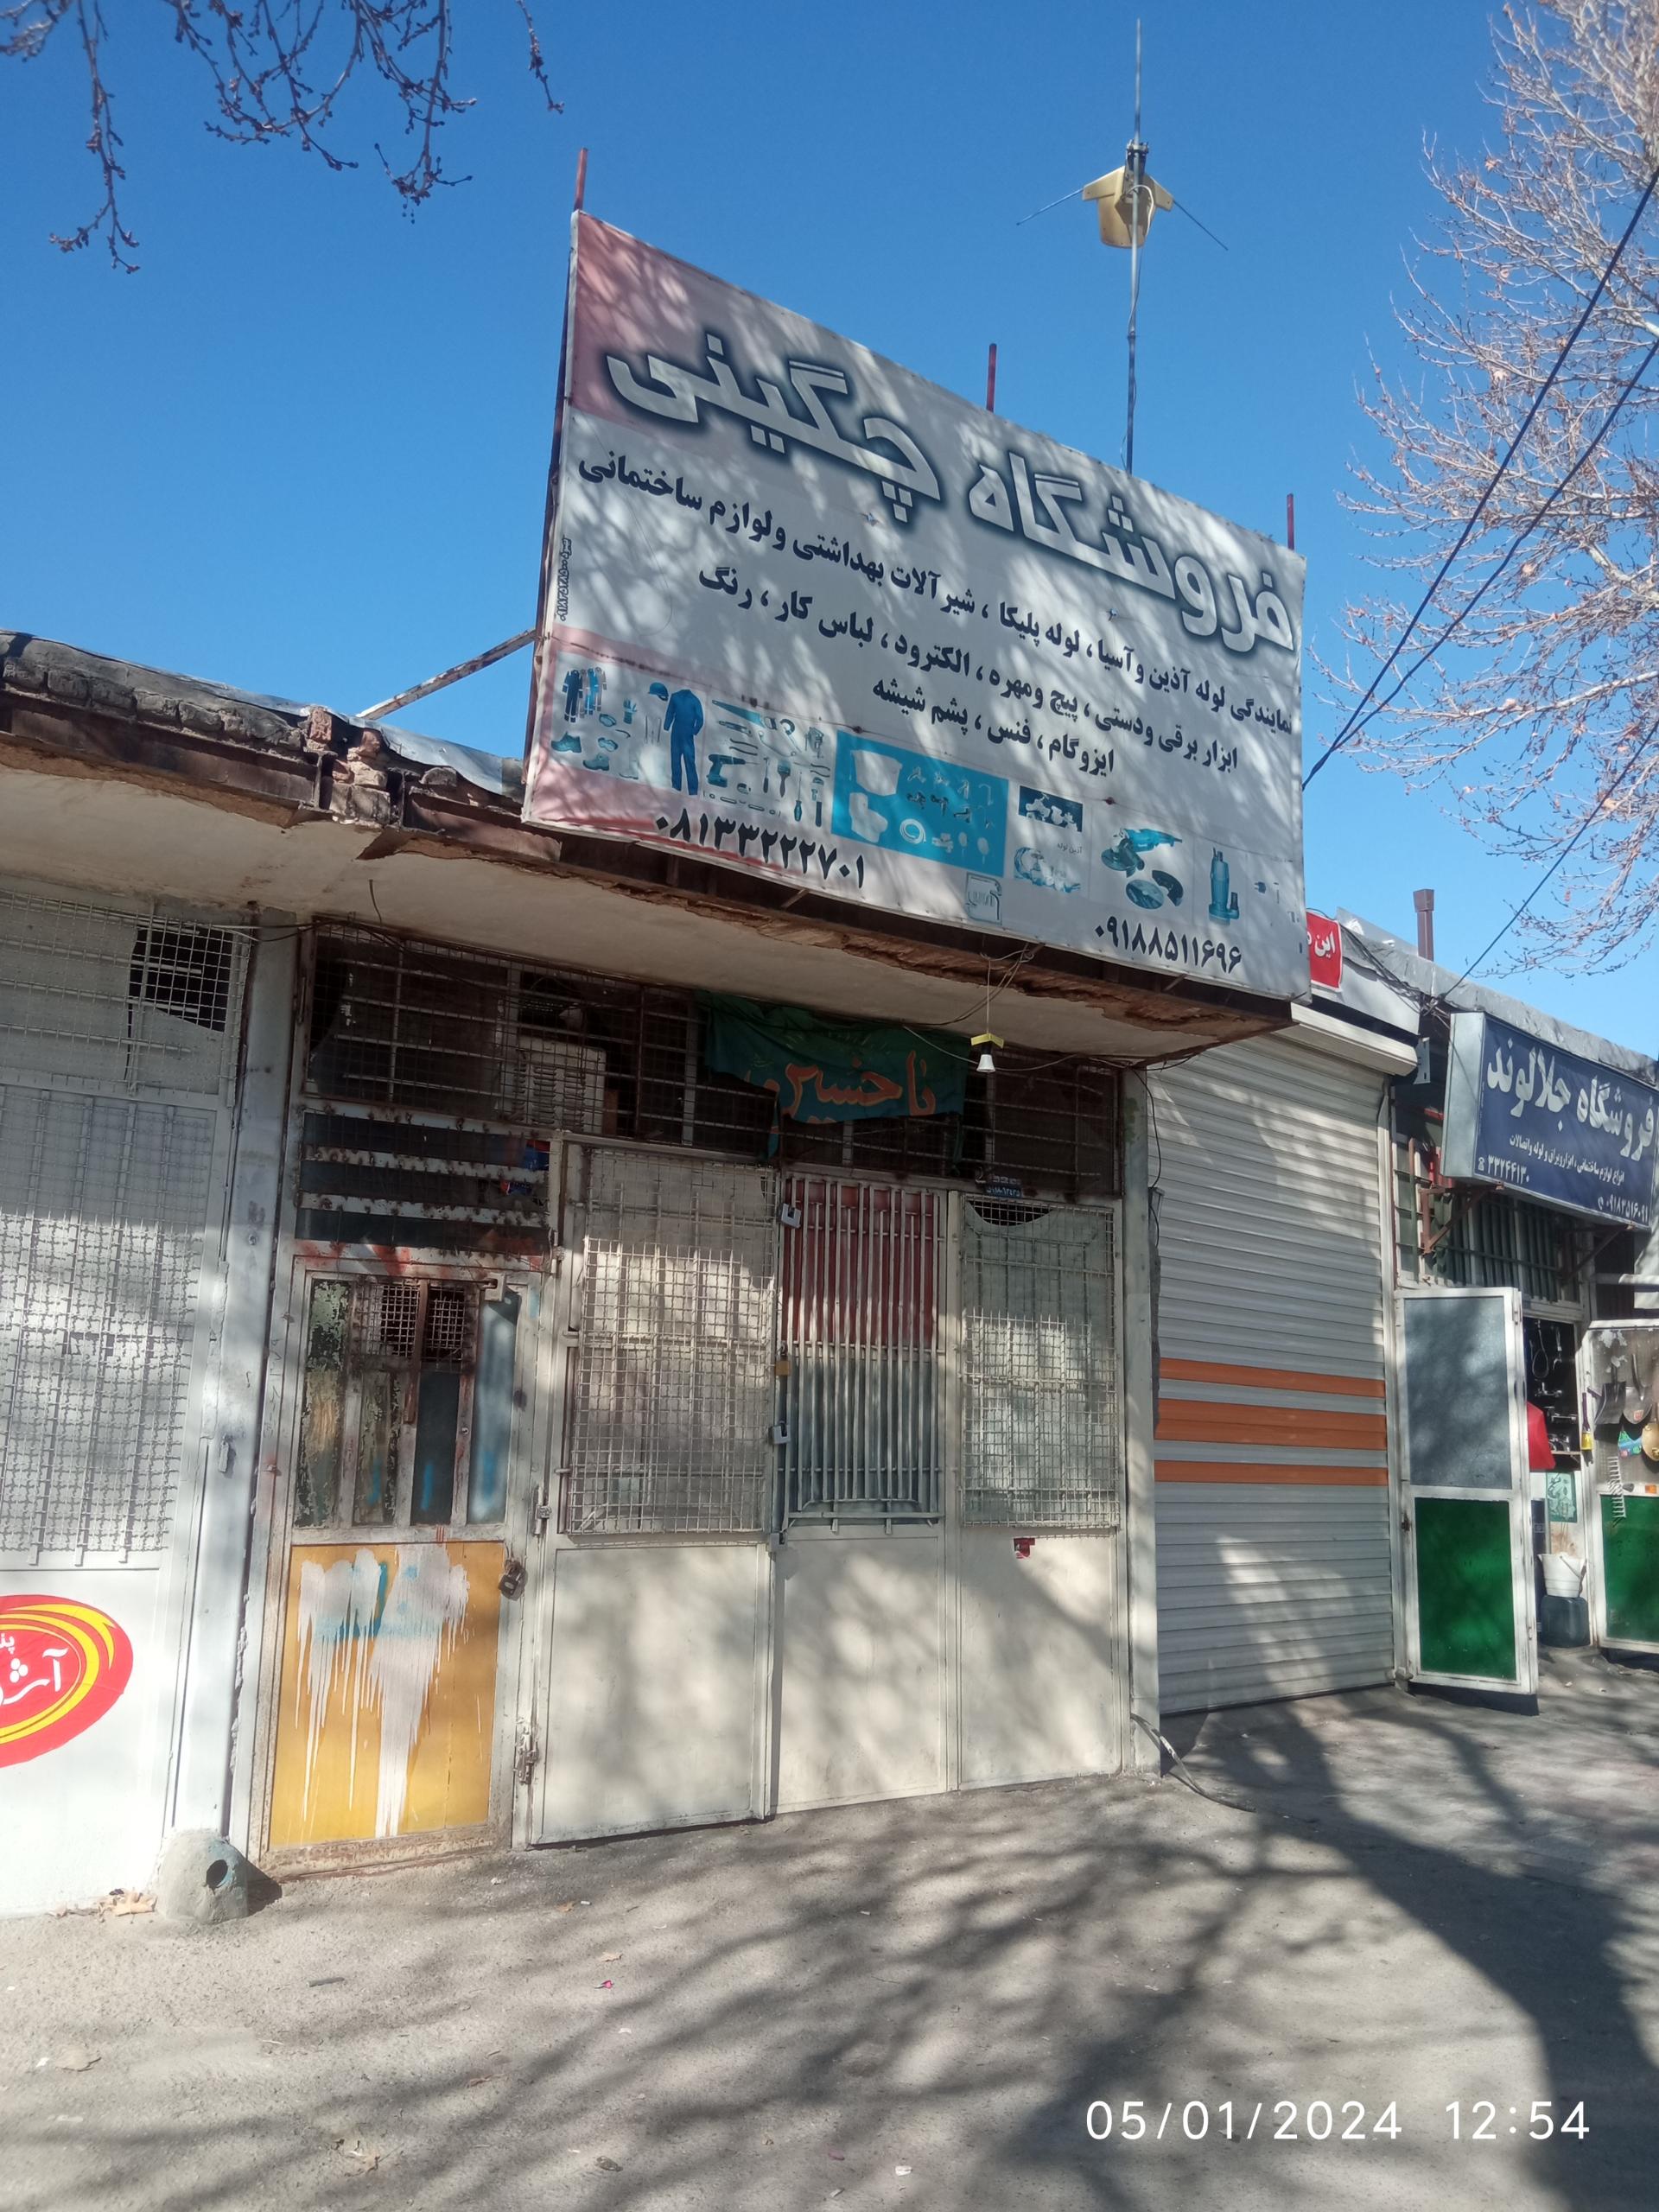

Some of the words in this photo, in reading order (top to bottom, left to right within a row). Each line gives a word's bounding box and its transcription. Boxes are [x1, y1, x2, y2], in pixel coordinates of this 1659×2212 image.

[606, 333, 941, 524] چگینی
[578, 450, 702, 511] ساختمانی
[793, 534, 884, 587] بهداشتی
[969, 451, 1294, 653] فروشگاه
[699, 567, 753, 609] رنگ
[774, 590, 813, 622] کار
[818, 612, 874, 647] لباس
[1000, 602, 1039, 646] پلیکا
[1046, 622, 1080, 658] لوله
[895, 634, 969, 677] الکترود
[872, 678, 925, 715] شیشه
[1149, 667, 1191, 693] آذین
[1196, 680, 1225, 712] لوله
[931, 698, 968, 734] پشم
[1050, 690, 1077, 722] پیچ
[1230, 699, 1293, 734] نمایندگی
[988, 719, 1031, 744] فنس
[1158, 724, 1198, 760] برقی
[1202, 741, 1237, 772] ابزار
[657, 808, 864, 889] ۰۸۱۳۳۲۲۲۷۰۱
[1095, 916, 1243, 974] ۰۹۱۸۸۵۱۱۶۹۶
[1314, 931, 1336, 958] این
[1487, 1038, 1572, 1132] جلالوند
[1577, 1074, 1655, 1162] فروشگاه
